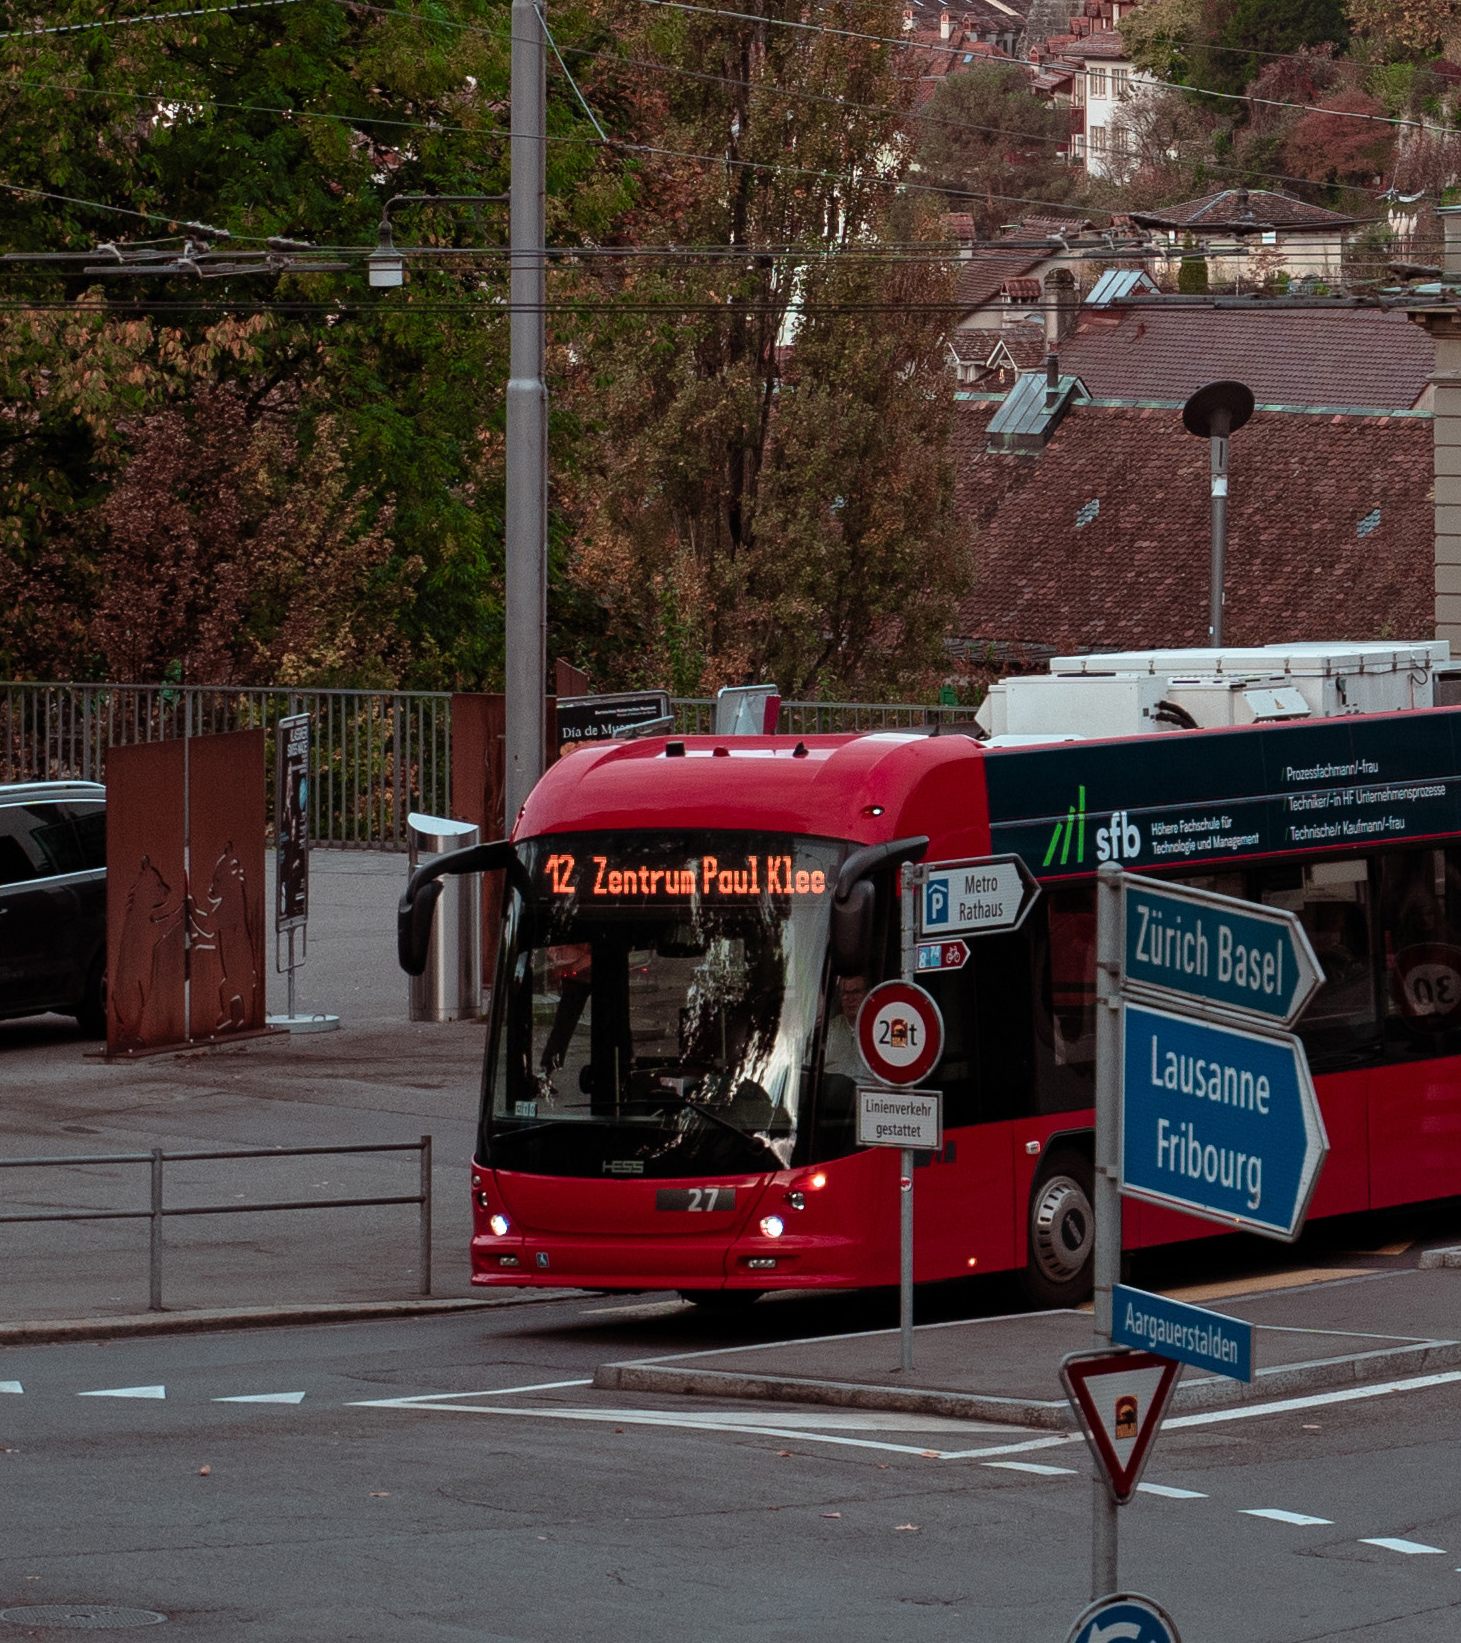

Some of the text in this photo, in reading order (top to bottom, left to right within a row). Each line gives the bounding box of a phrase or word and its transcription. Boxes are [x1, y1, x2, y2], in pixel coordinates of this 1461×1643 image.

[584, 724, 598, 737] de
[1342, 790, 1355, 806] HF
[1096, 811, 1141, 861] sfb
[1151, 815, 1233, 836] Höhere Fachschule für
[1152, 832, 1260, 856] Technologie und Management
[544, 854, 826, 894] 12 Zentrum Paul Klee
[965, 875, 998, 895] Metro
[959, 899, 1004, 922] Rathaus
[1135, 904, 1283, 996] Zürich Basel
[879, 1020, 918, 1046] 2t
[1151, 1034, 1271, 1115] Lausanne
[865, 1098, 932, 1117] Linienverkehr
[876, 1122, 921, 1138] gestattet
[1156, 1117, 1263, 1211] Fribourg
[688, 1188, 720, 1212] 27
[1124, 1301, 1239, 1365] Aargauerstalden
